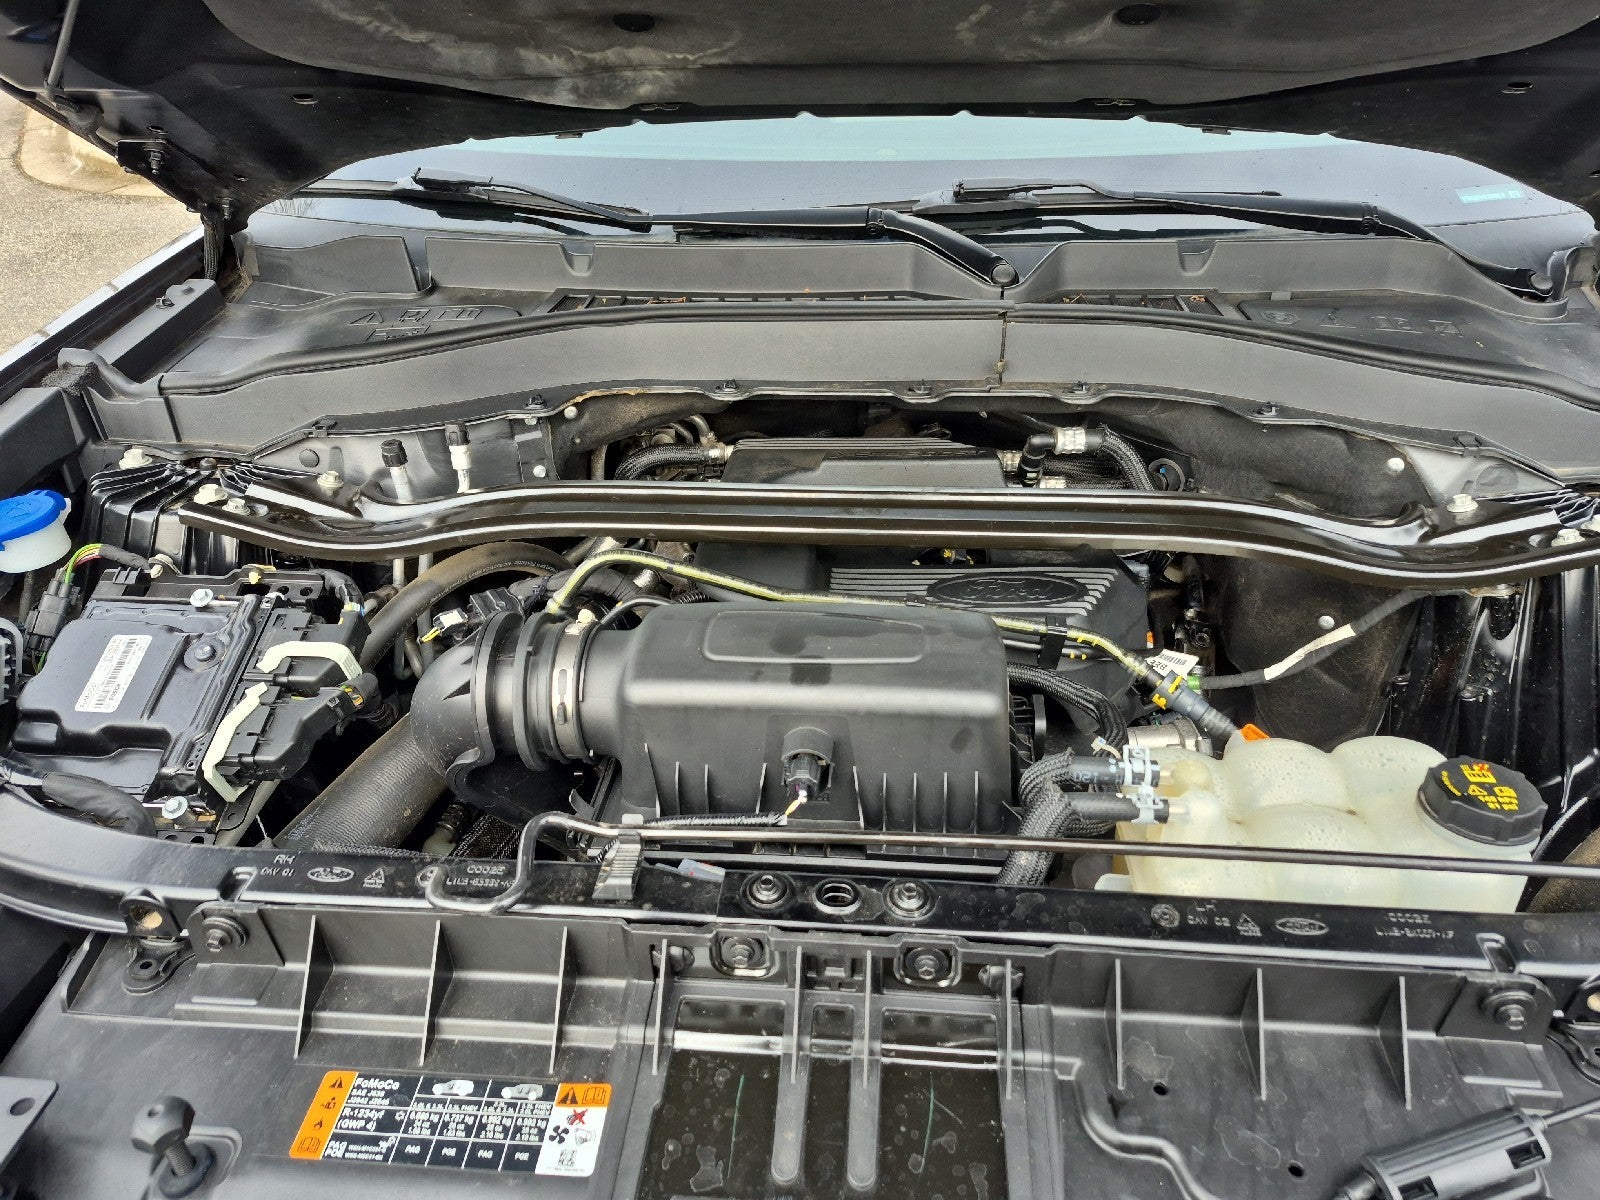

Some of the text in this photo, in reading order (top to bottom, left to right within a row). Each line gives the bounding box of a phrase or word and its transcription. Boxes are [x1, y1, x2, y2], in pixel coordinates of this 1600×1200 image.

[355, 1077, 400, 1090] FoMoCo
[342, 1107, 386, 1120] R-1234yf
[337, 1118, 377, 1132] (GWP 4)
[404, 1144, 421, 1154] PAG
[477, 1149, 494, 1159] PAG
